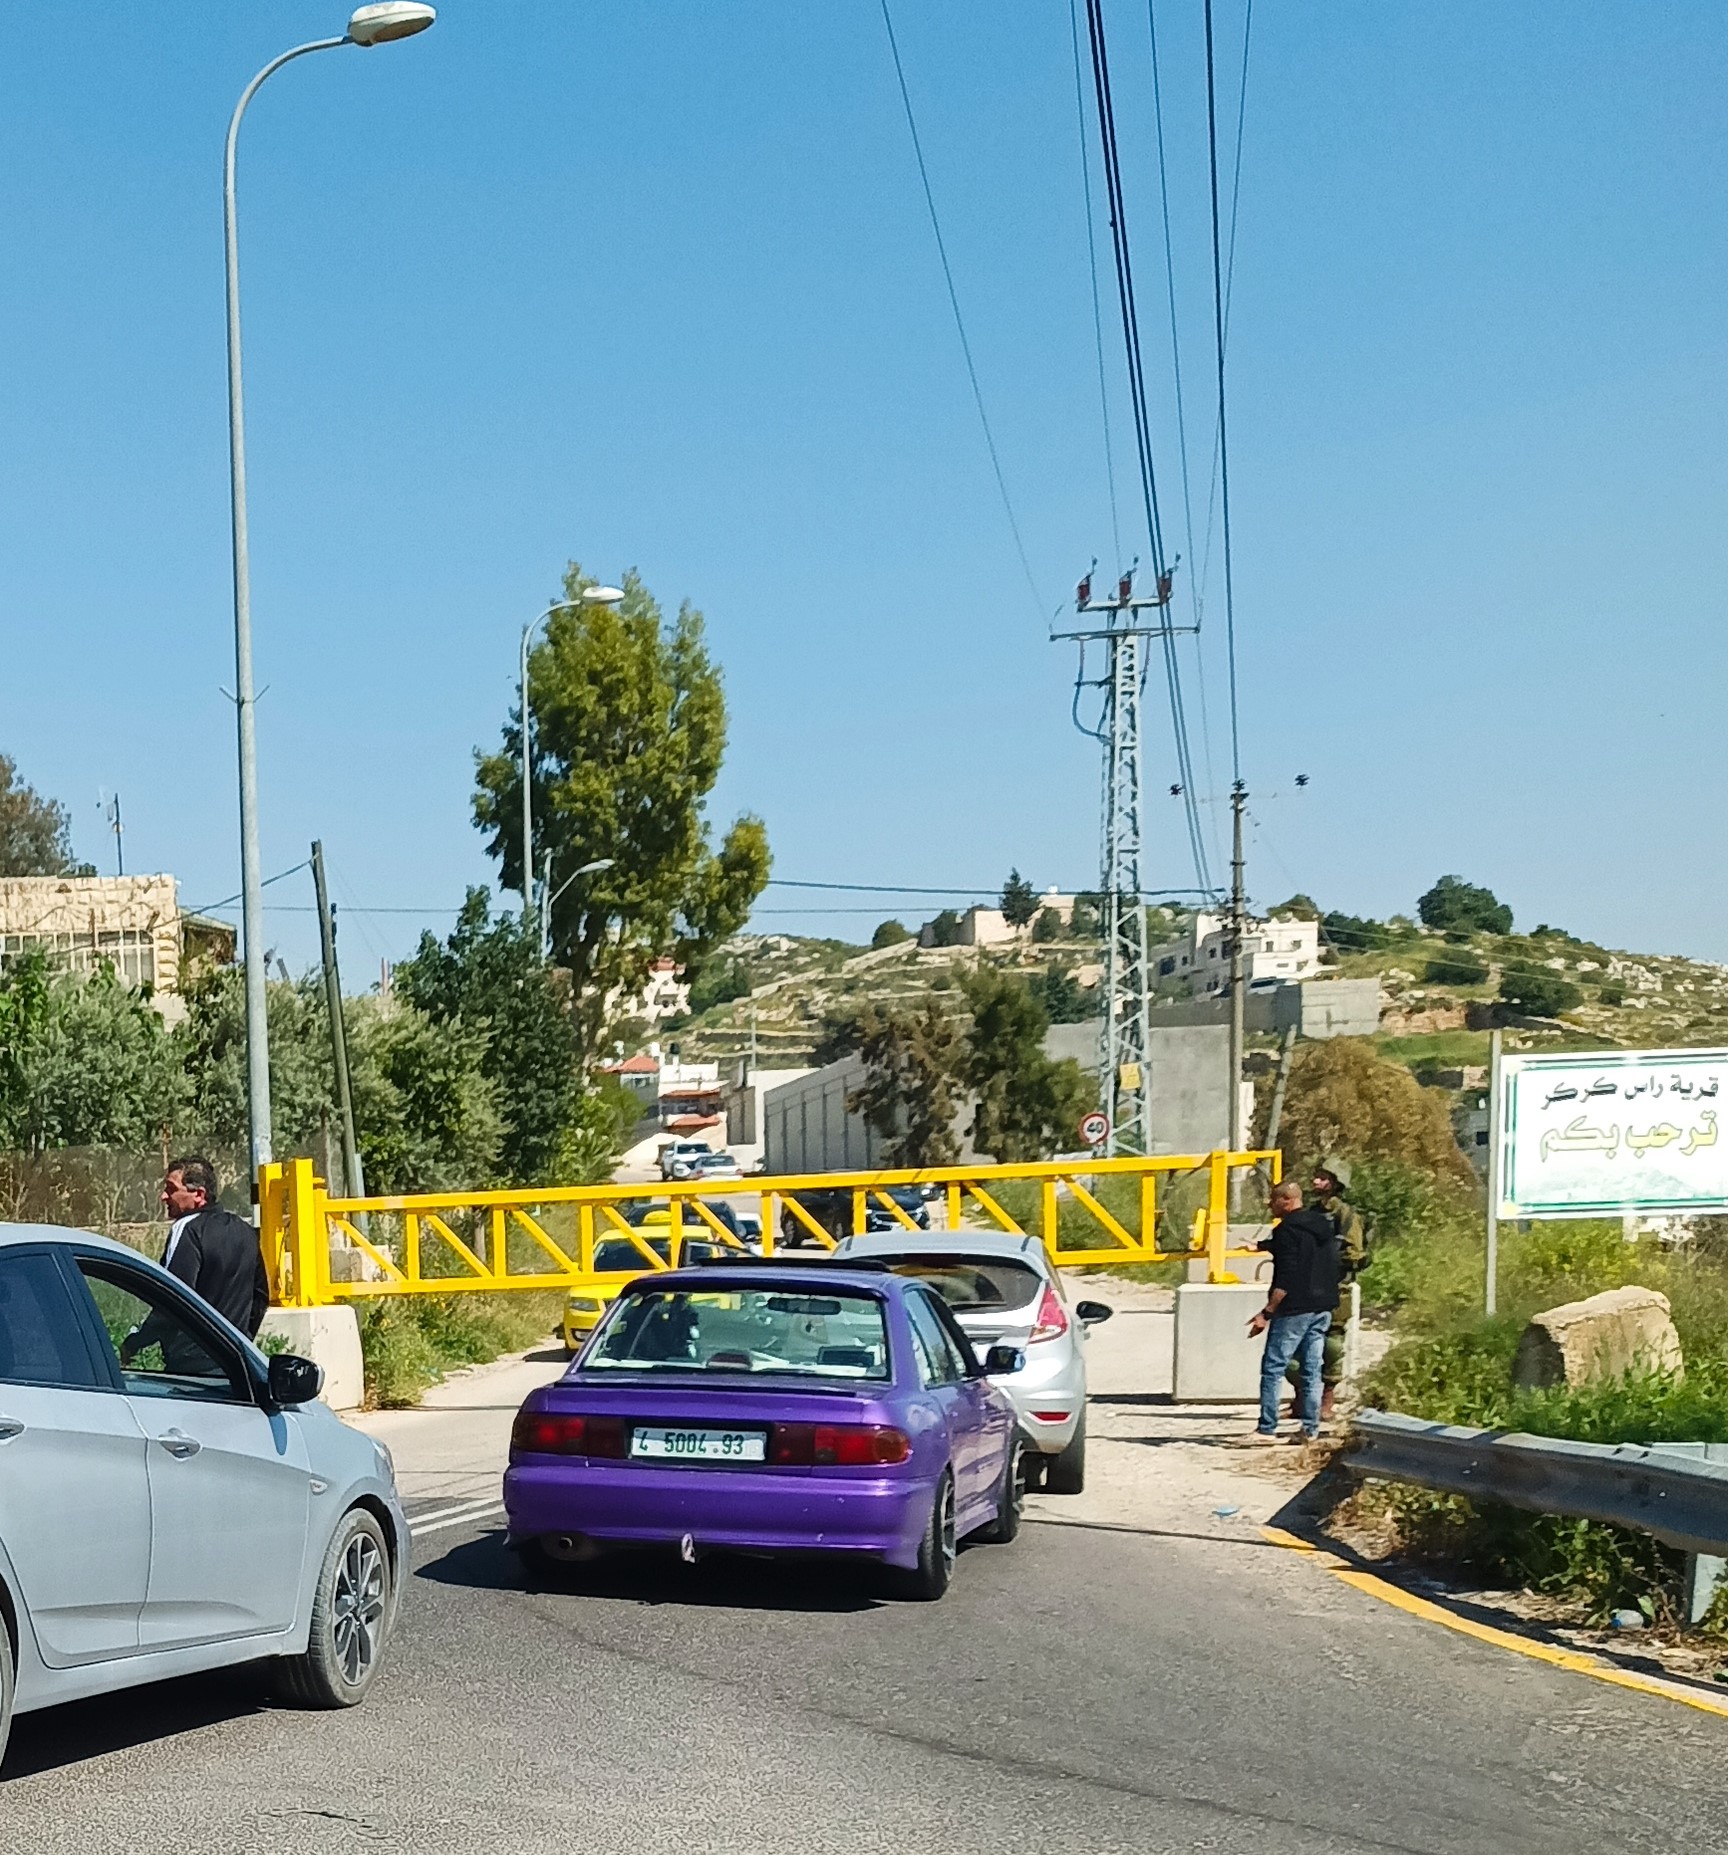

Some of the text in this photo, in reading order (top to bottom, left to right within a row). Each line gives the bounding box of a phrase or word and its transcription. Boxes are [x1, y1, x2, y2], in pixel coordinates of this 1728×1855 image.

[1540, 1074, 1719, 1110] قرية راس كركر
[1087, 1121, 1104, 1134] 40
[1540, 1110, 1718, 1163] ترحب بكم
